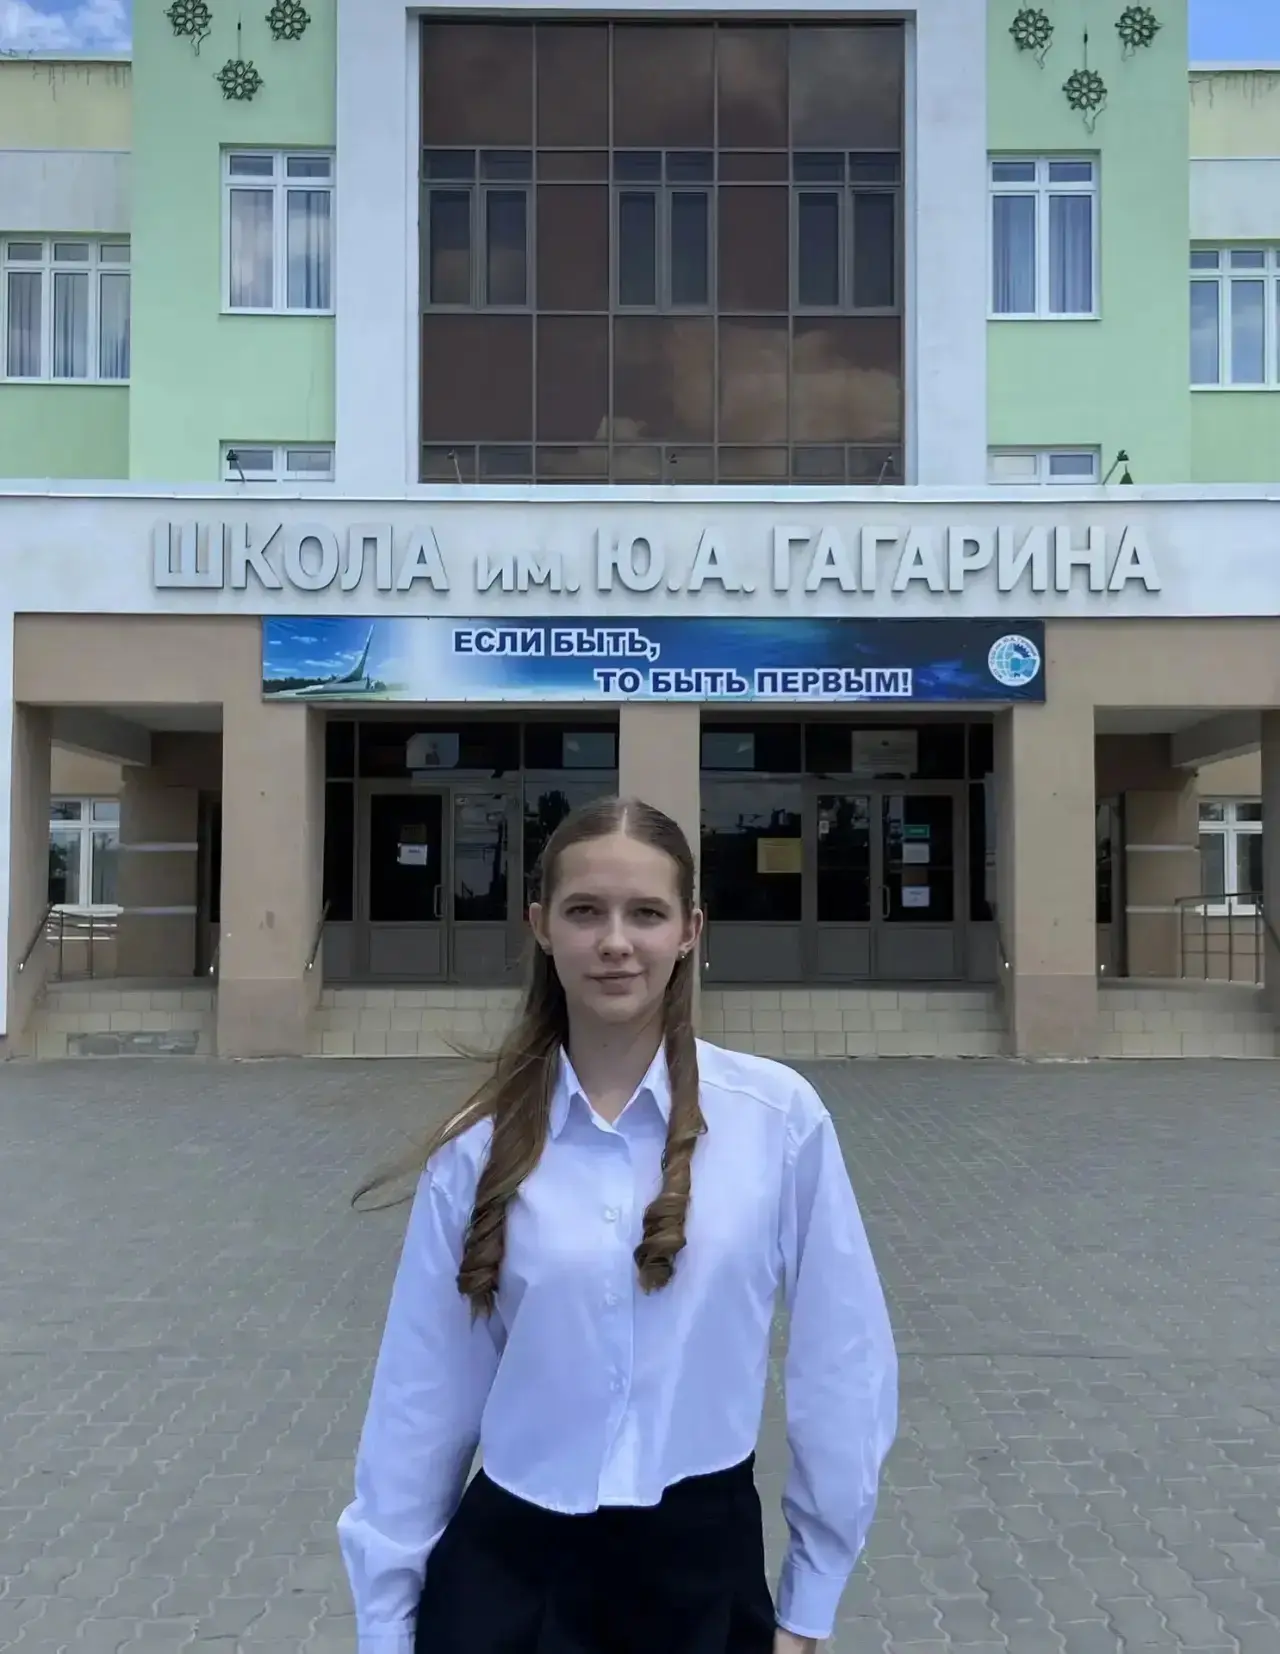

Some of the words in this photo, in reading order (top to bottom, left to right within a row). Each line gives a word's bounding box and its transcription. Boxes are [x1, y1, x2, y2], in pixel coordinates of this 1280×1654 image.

[153, 522, 450, 591] ШКОЛА
[476, 551, 581, 592] им.
[596, 525, 756, 592] Ю.А.
[773, 524, 1162, 592] ГАГАРИНА
[453, 628, 543, 657] ЕСЛИ
[552, 628, 660, 660] БЫТЬ,
[594, 668, 641, 694] ТО
[651, 668, 748, 694] БЫТЬ
[757, 668, 913, 695] ПЕРВЫМ!
